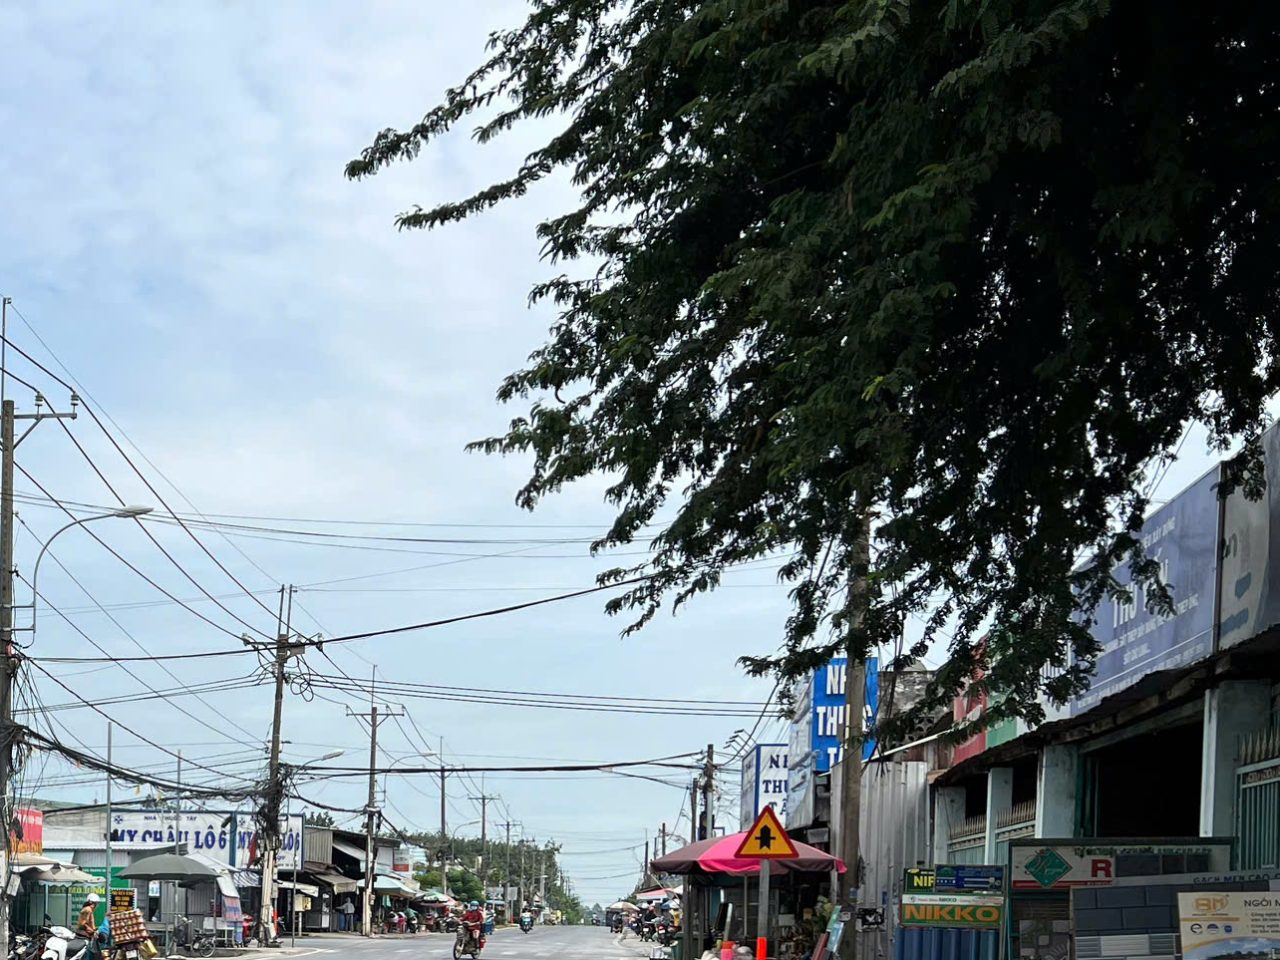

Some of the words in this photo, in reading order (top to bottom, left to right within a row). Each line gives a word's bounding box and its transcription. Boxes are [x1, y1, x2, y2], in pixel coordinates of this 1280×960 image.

[194, 825, 215, 849] LÔ
[218, 830, 227, 849] 6
[904, 904, 1000, 922] NIKKO
